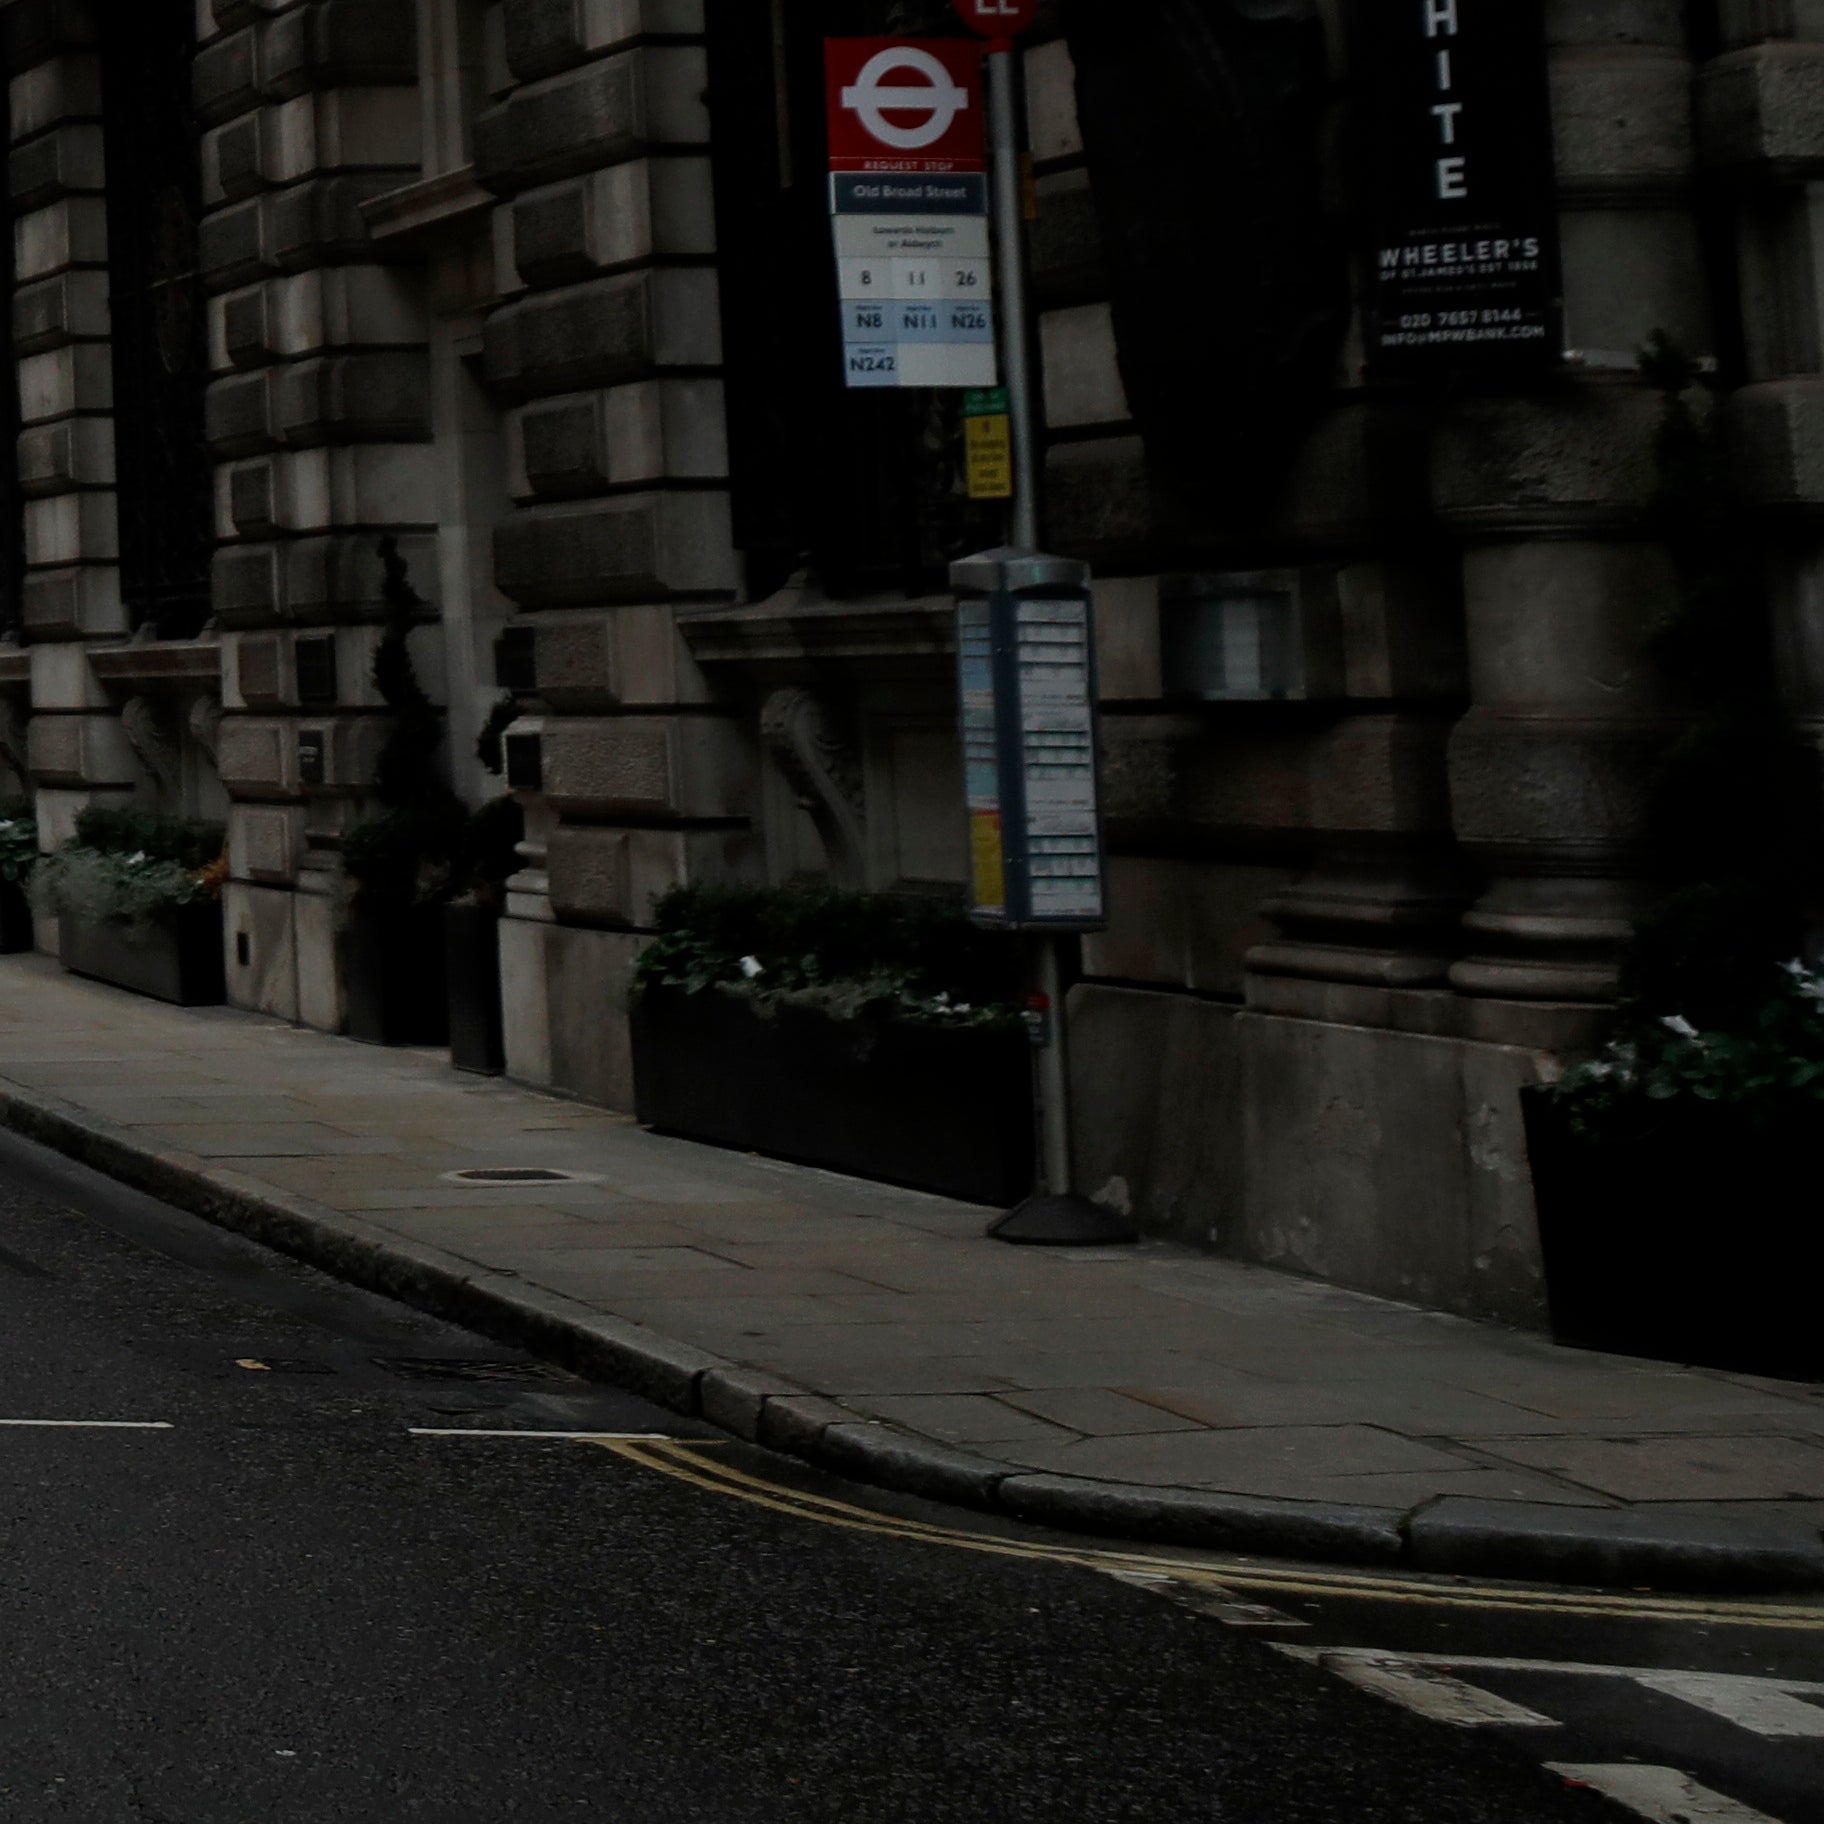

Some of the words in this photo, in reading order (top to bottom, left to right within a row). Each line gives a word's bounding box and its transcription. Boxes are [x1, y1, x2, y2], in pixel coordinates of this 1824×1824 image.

[863, 160, 919, 170] REQUEST
[924, 161, 955, 171] STOP
[853, 184, 880, 198] Old
[882, 184, 923, 198] Broad
[925, 184, 968, 199] Street
[1378, 236, 1540, 269] WHEELER'S
[861, 270, 872, 285] 8
[909, 271, 926, 286] 11
[956, 270, 977, 286] 26
[856, 313, 883, 328] N8
[904, 313, 938, 329] N11
[952, 313, 987, 329] N26
[1399, 312, 1432, 330] 020
[850, 356, 895, 371] N242
